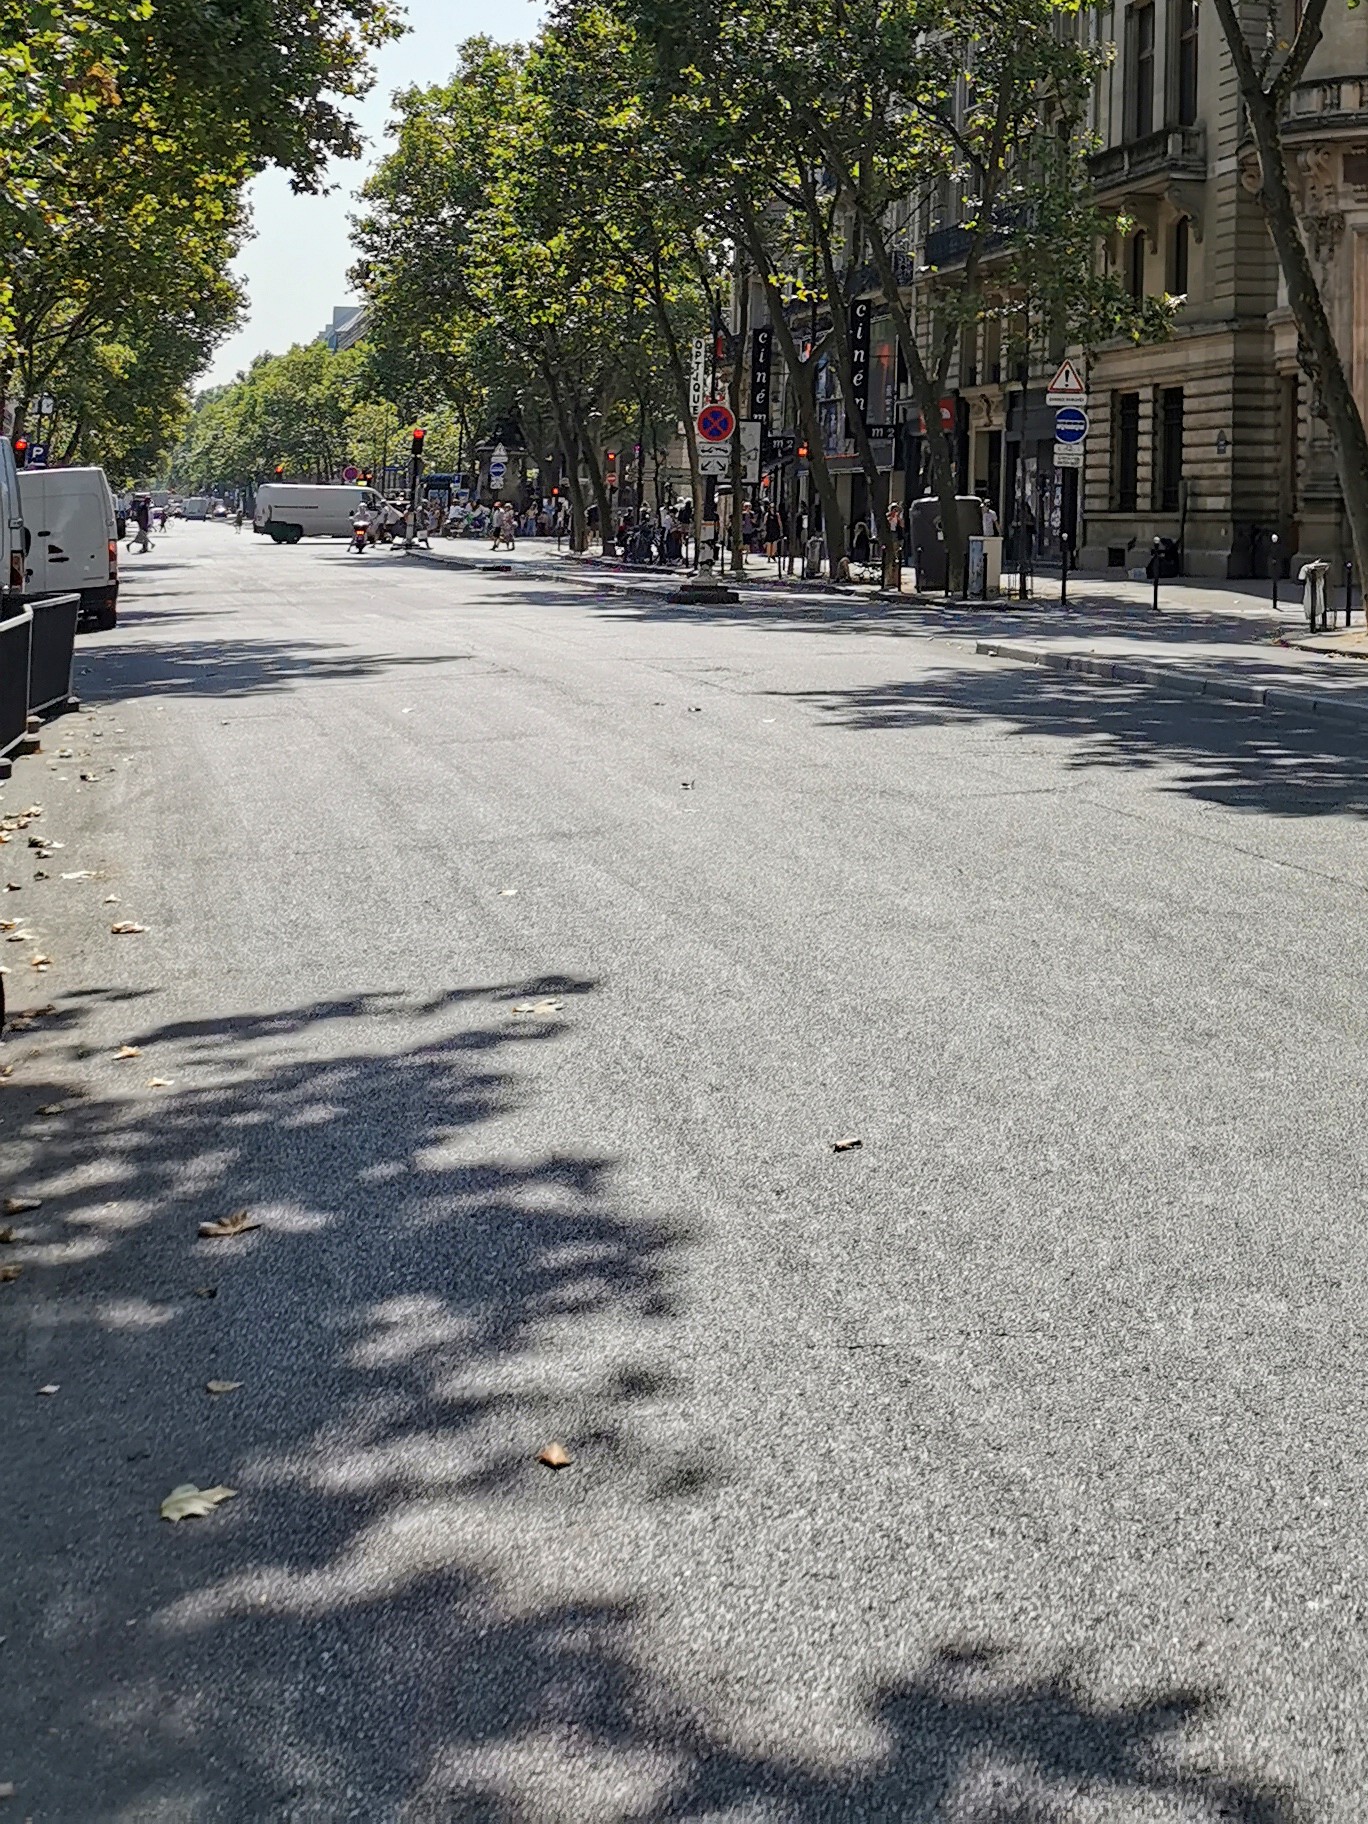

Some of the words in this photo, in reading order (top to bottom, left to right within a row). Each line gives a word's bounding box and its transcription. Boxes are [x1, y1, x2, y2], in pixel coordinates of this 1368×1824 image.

[691, 339, 703, 415] OPTIQUE
[753, 331, 768, 425] ciném
[852, 303, 867, 411] ciném
[32, 446, 44, 459] P
